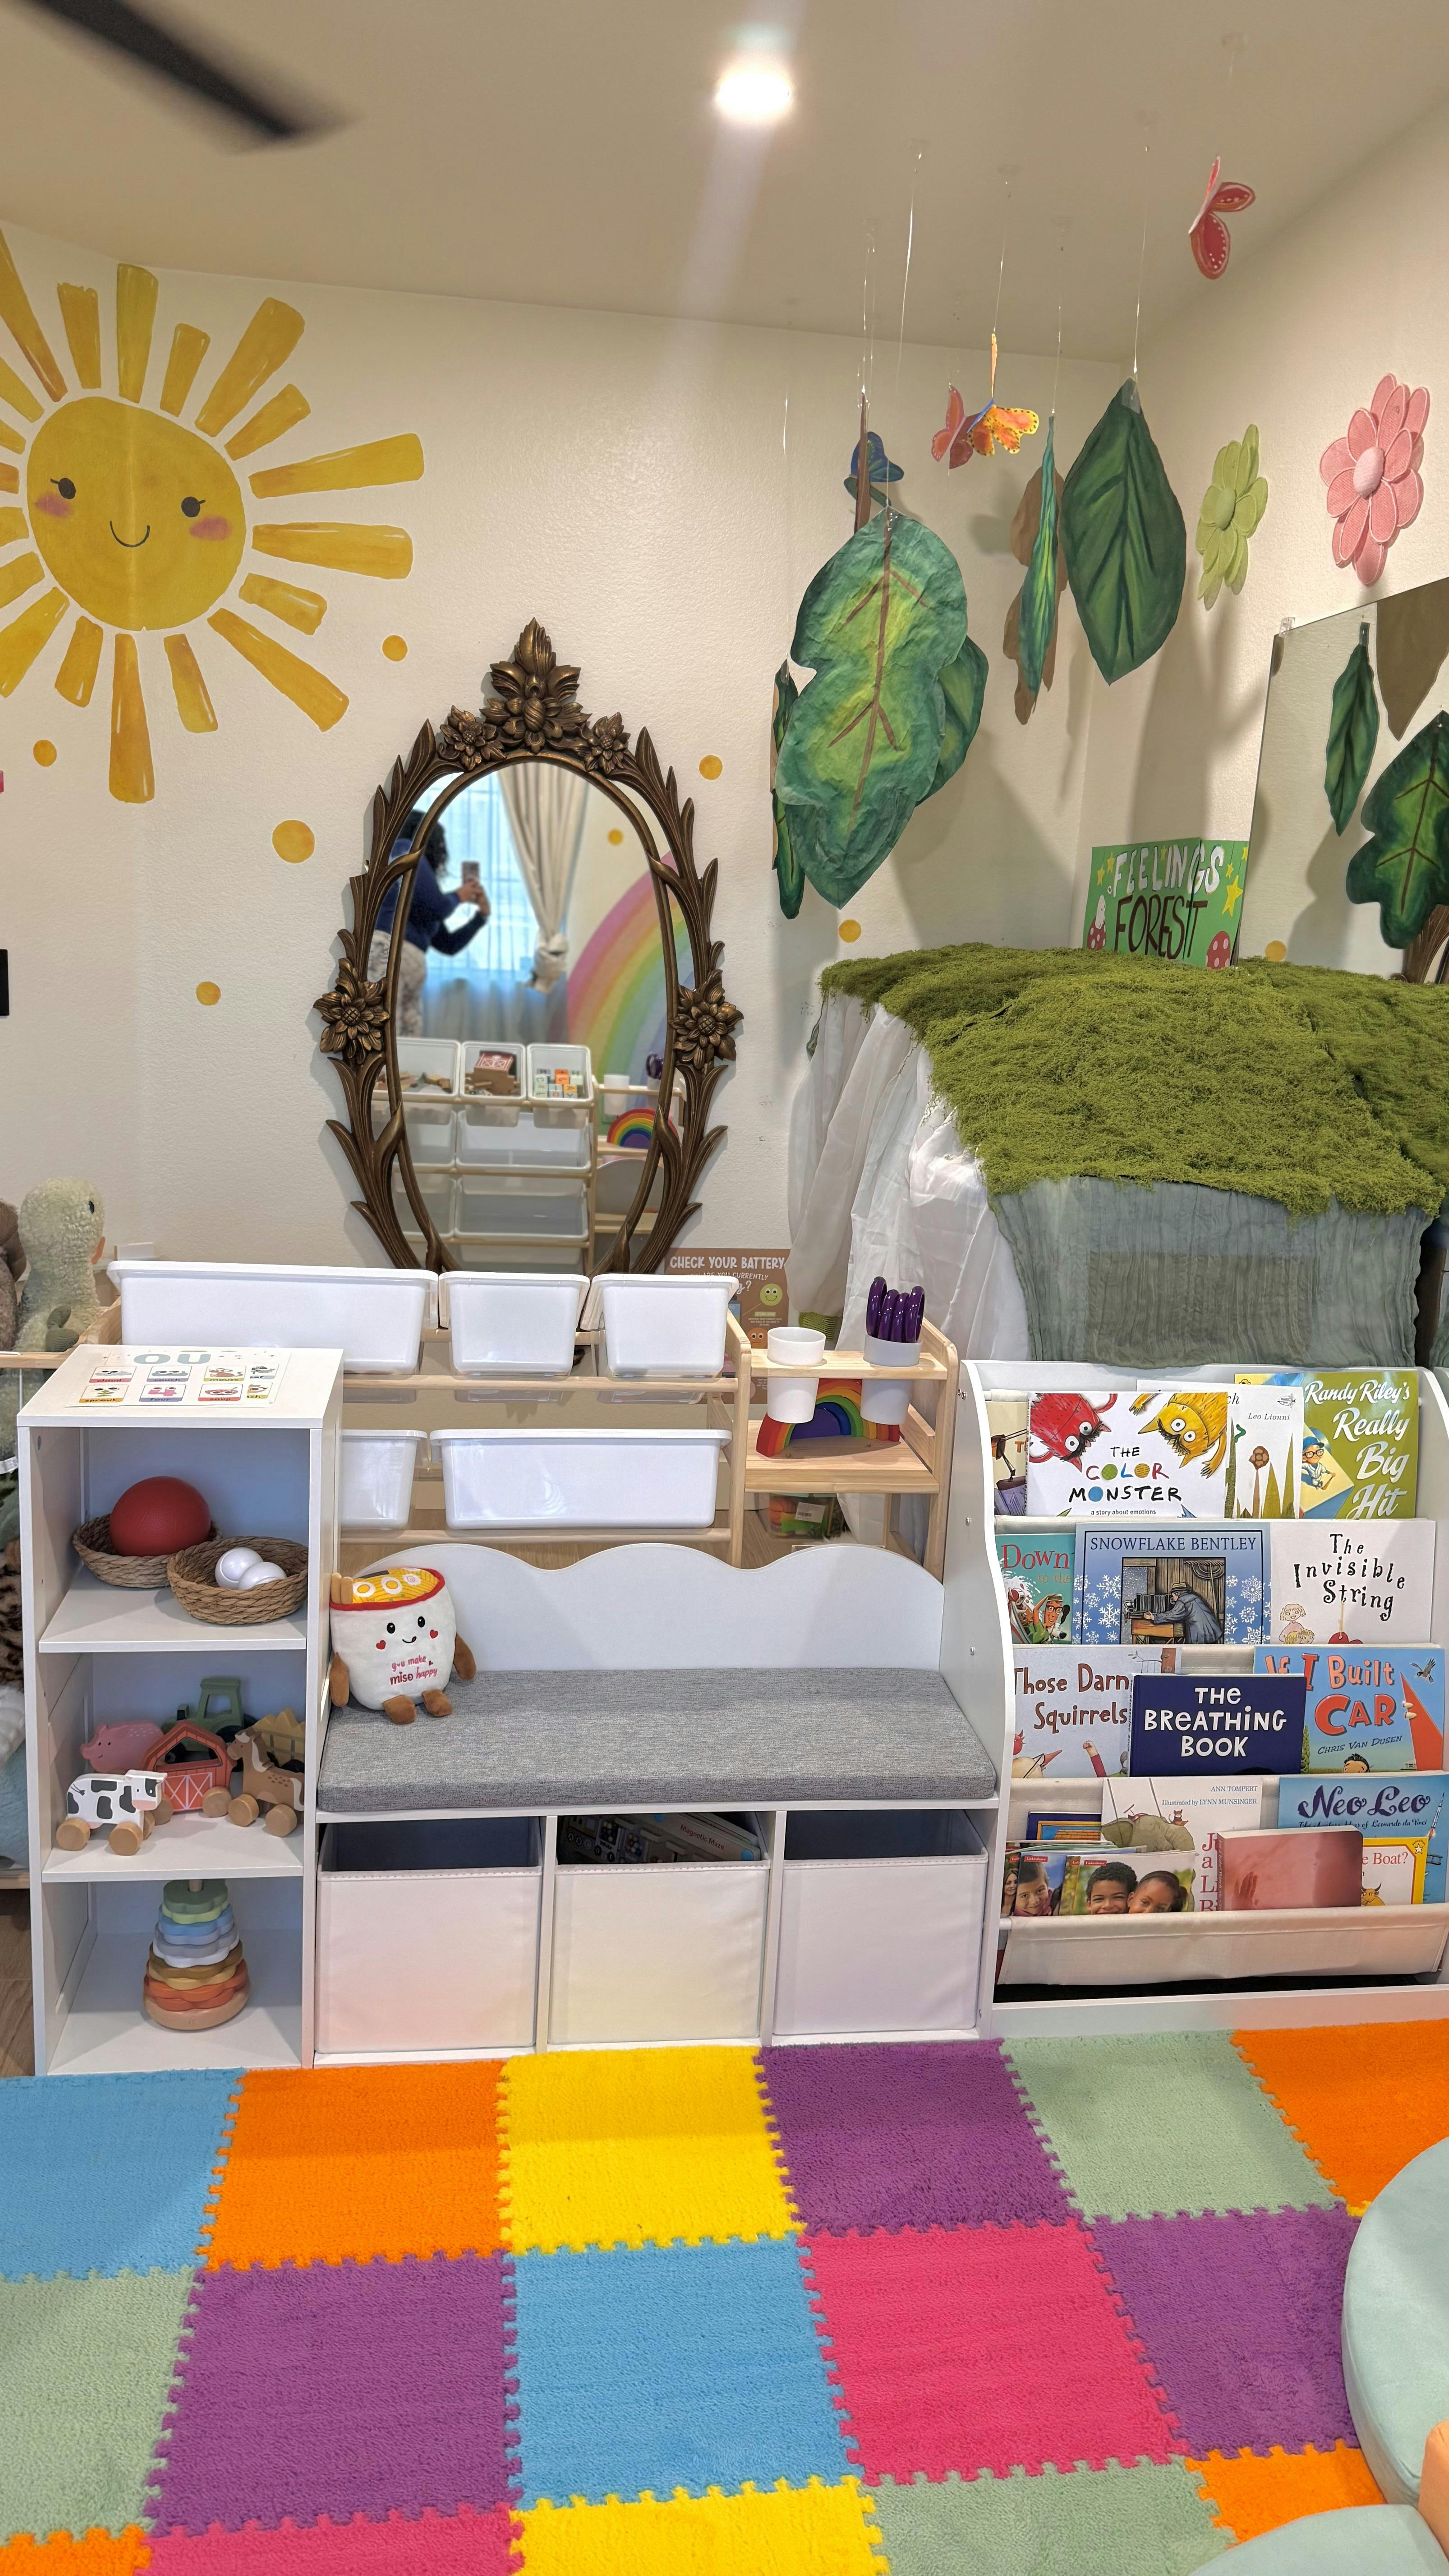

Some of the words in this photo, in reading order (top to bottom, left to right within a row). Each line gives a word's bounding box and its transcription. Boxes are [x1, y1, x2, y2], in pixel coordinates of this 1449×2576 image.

[1113, 844, 1224, 897] FEELINGS
[1113, 894, 1209, 960] FOREST
[670, 1256, 705, 1269] CHECK
[708, 1256, 737, 1269] YOUR
[741, 1257, 785, 1270] BATTERY
[732, 1272, 769, 1280] CURRENTLY
[1304, 1379, 1359, 1405] Randy
[1359, 1380, 1410, 1404] Riley's
[1332, 1408, 1411, 1442] Really
[1110, 1446, 1140, 1458] THE
[1356, 1441, 1410, 1484] Big
[1086, 1463, 1170, 1481] COLOR
[1069, 1486, 1182, 1503] MONSTER
[1346, 1483, 1408, 1519] Hit
[1090, 1537, 1185, 1551] SNOWFLAKE
[1191, 1536, 1257, 1550] BENTLEY
[1329, 1533, 1364, 1554] The
[1000, 1544, 1071, 1571] Down
[1293, 1556, 1405, 1589] Invisible
[1323, 1579, 1394, 1622] String
[390, 1672, 414, 1685] miso
[415, 1667, 438, 1680] happy
[391, 1660, 405, 1671] you
[408, 1655, 427, 1665] make
[1265, 1654, 1290, 1674] If
[1327, 1654, 1395, 1689] Built
[1014, 1667, 1067, 1695] Those
[1078, 1663, 1129, 1693] Darn
[1034, 1702, 1128, 1734] Squirrels
[1314, 1693, 1398, 1737] CAR
[1181, 1735, 1248, 1757] BOOK
[1317, 1744, 1345, 1755] CHRIS
[1348, 1740, 1367, 1751] VAN
[1371, 1735, 1403, 1747] DUSEN
[1297, 1785, 1366, 1818] Neo
[1367, 1786, 1431, 1817] Leo
[680, 1824, 708, 1842] Magnetic
[708, 1837, 725, 1850] Maze
[1362, 1821, 1368, 1830] of
[1372, 1819, 1401, 1827] Leonardo
[1412, 1818, 1427, 1826] Vinci
[1201, 1856, 1213, 1869] a
[1372, 1851, 1408, 1865] Boat?
